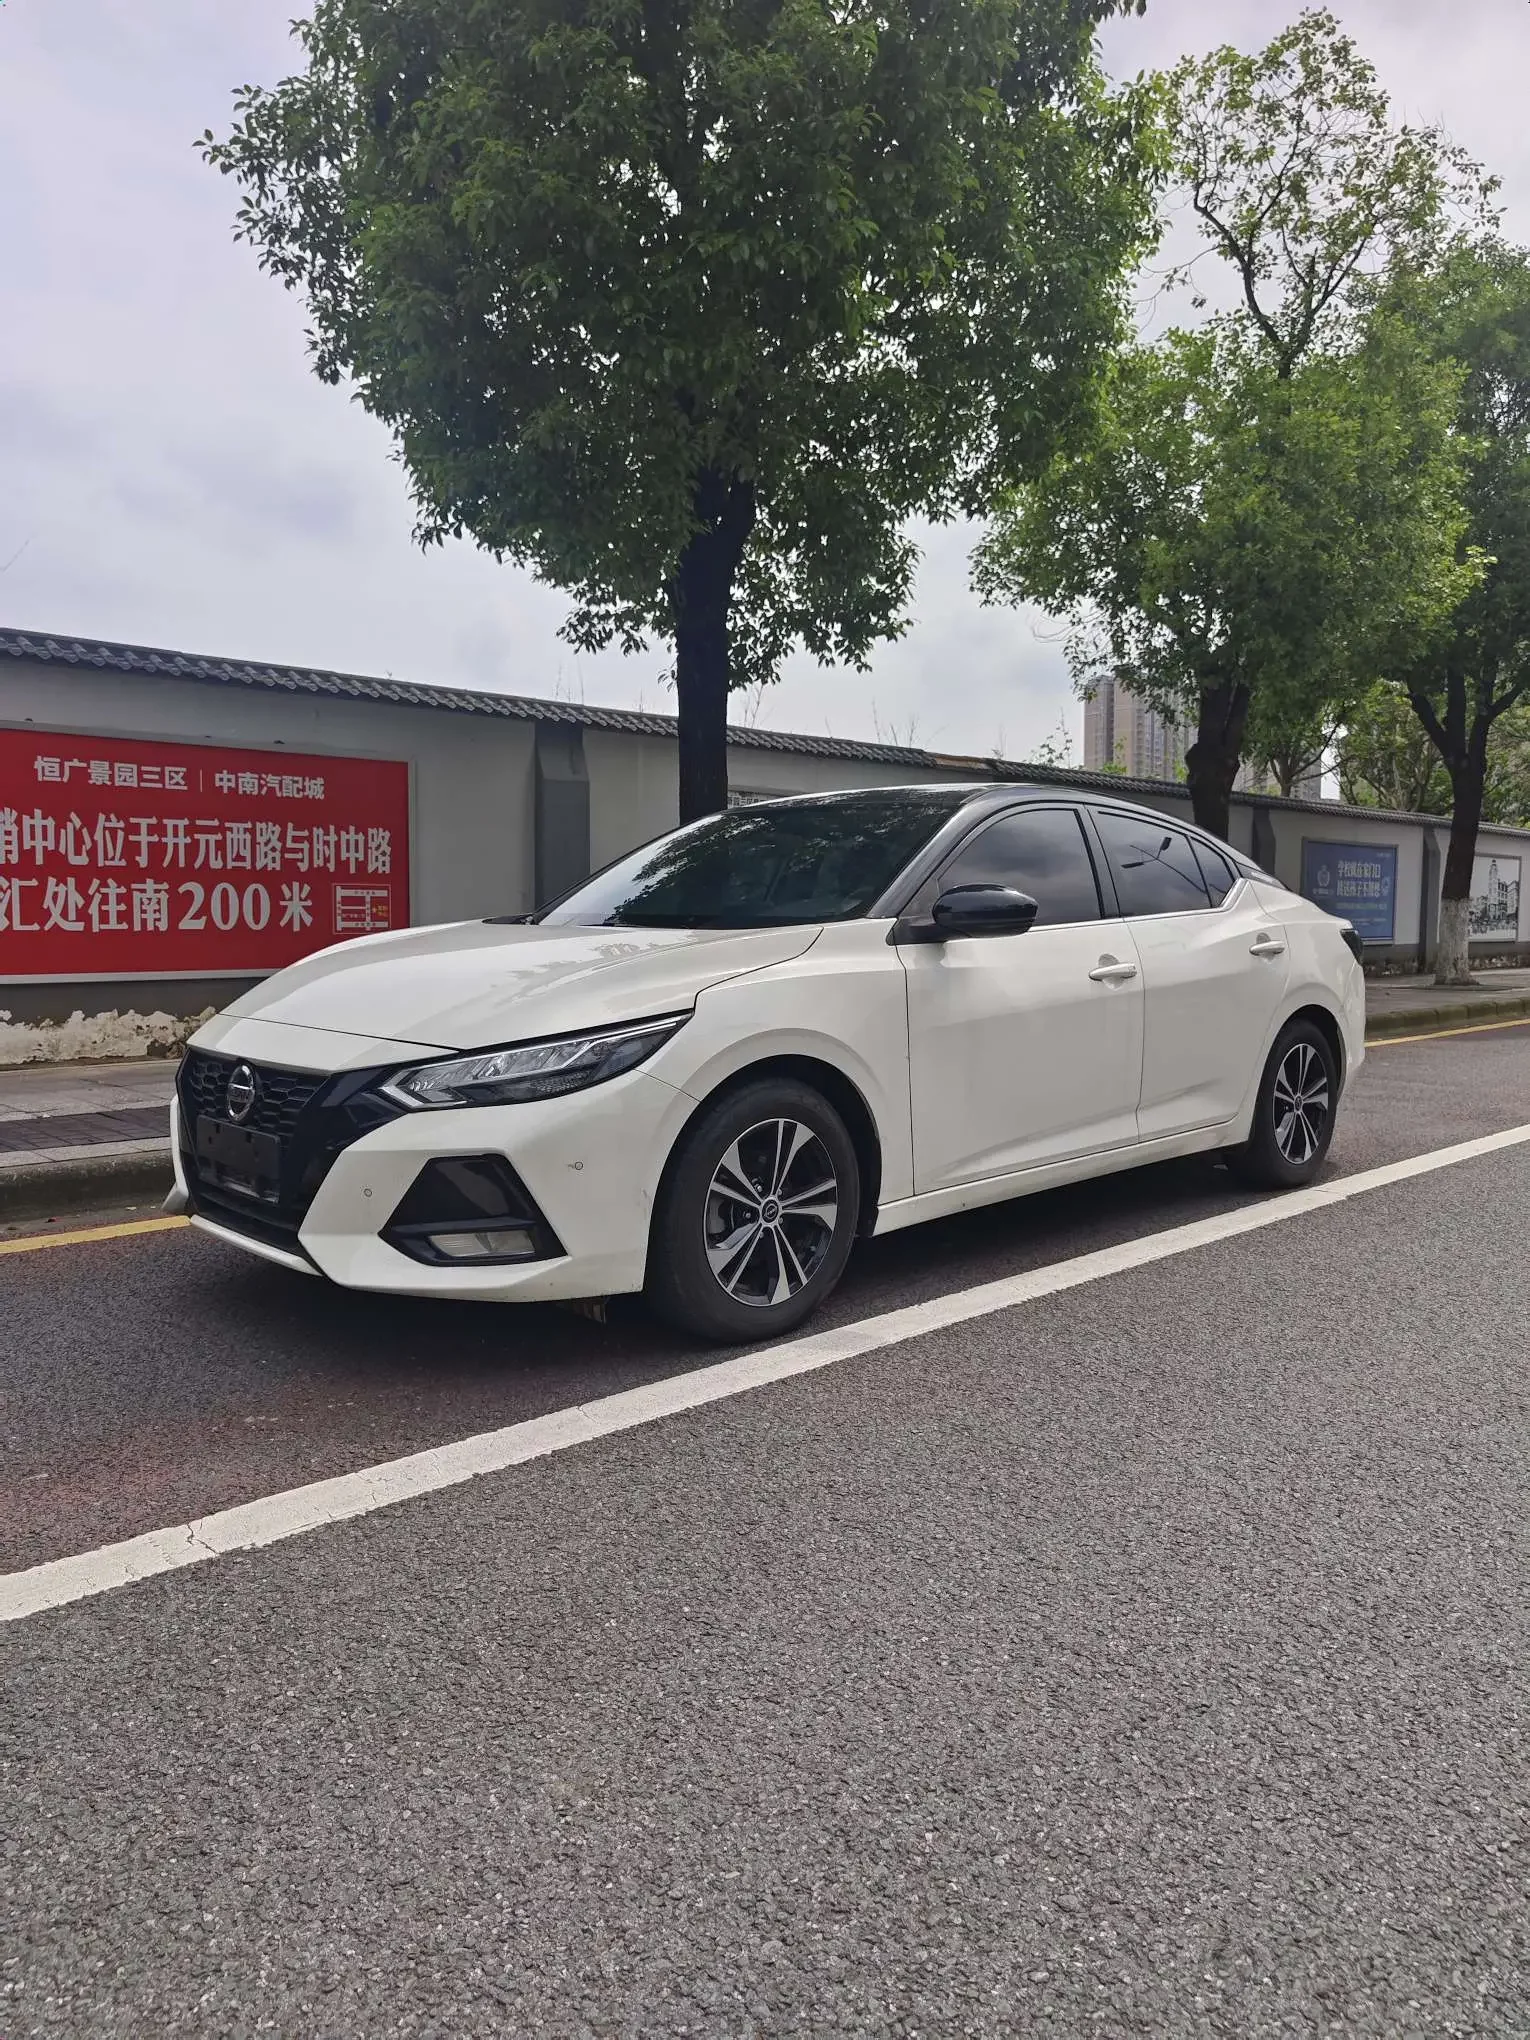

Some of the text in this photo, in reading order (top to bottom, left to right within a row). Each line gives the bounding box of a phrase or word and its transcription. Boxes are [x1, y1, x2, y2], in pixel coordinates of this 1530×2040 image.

[35, 757, 325, 800] 恒广景园三区 中南汽配城
